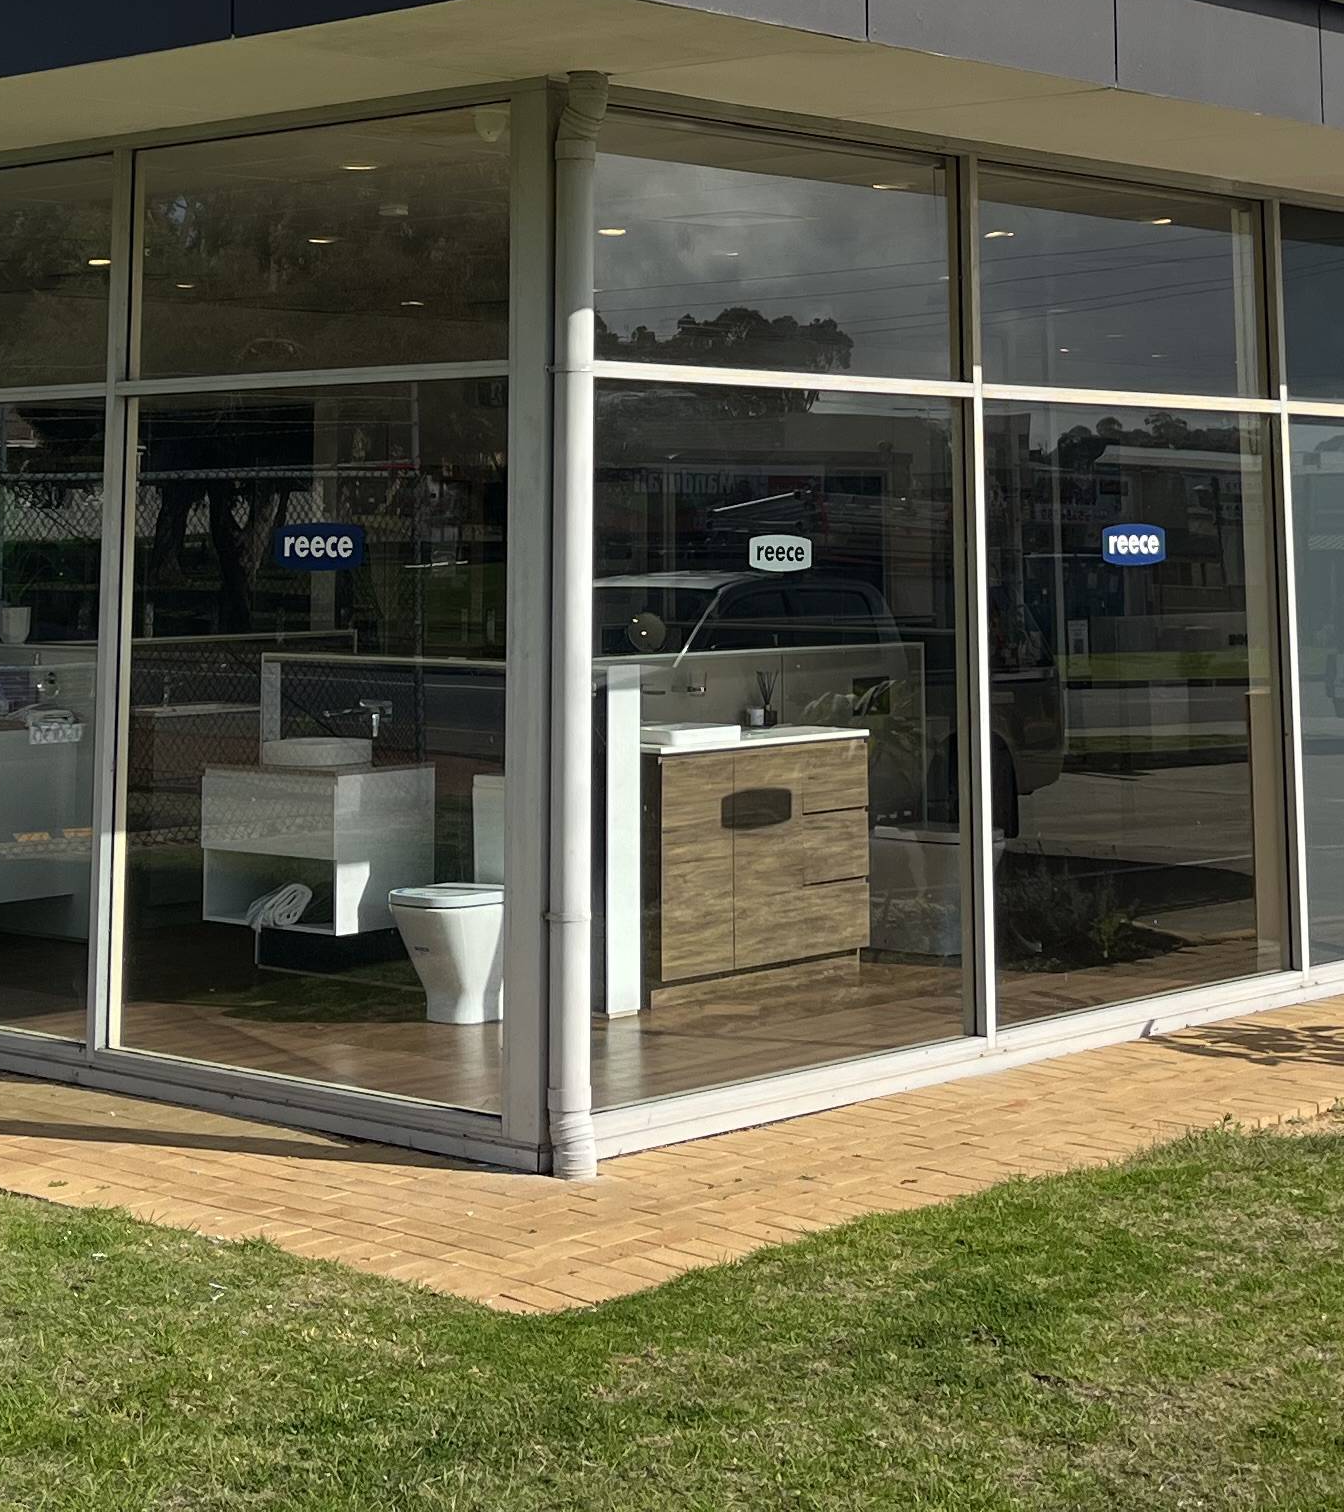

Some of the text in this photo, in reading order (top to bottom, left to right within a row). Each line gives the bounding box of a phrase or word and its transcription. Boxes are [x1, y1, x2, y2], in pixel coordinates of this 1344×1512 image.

[282, 531, 354, 561] reece
[756, 541, 806, 562] reece
[1107, 532, 1160, 556] reece
